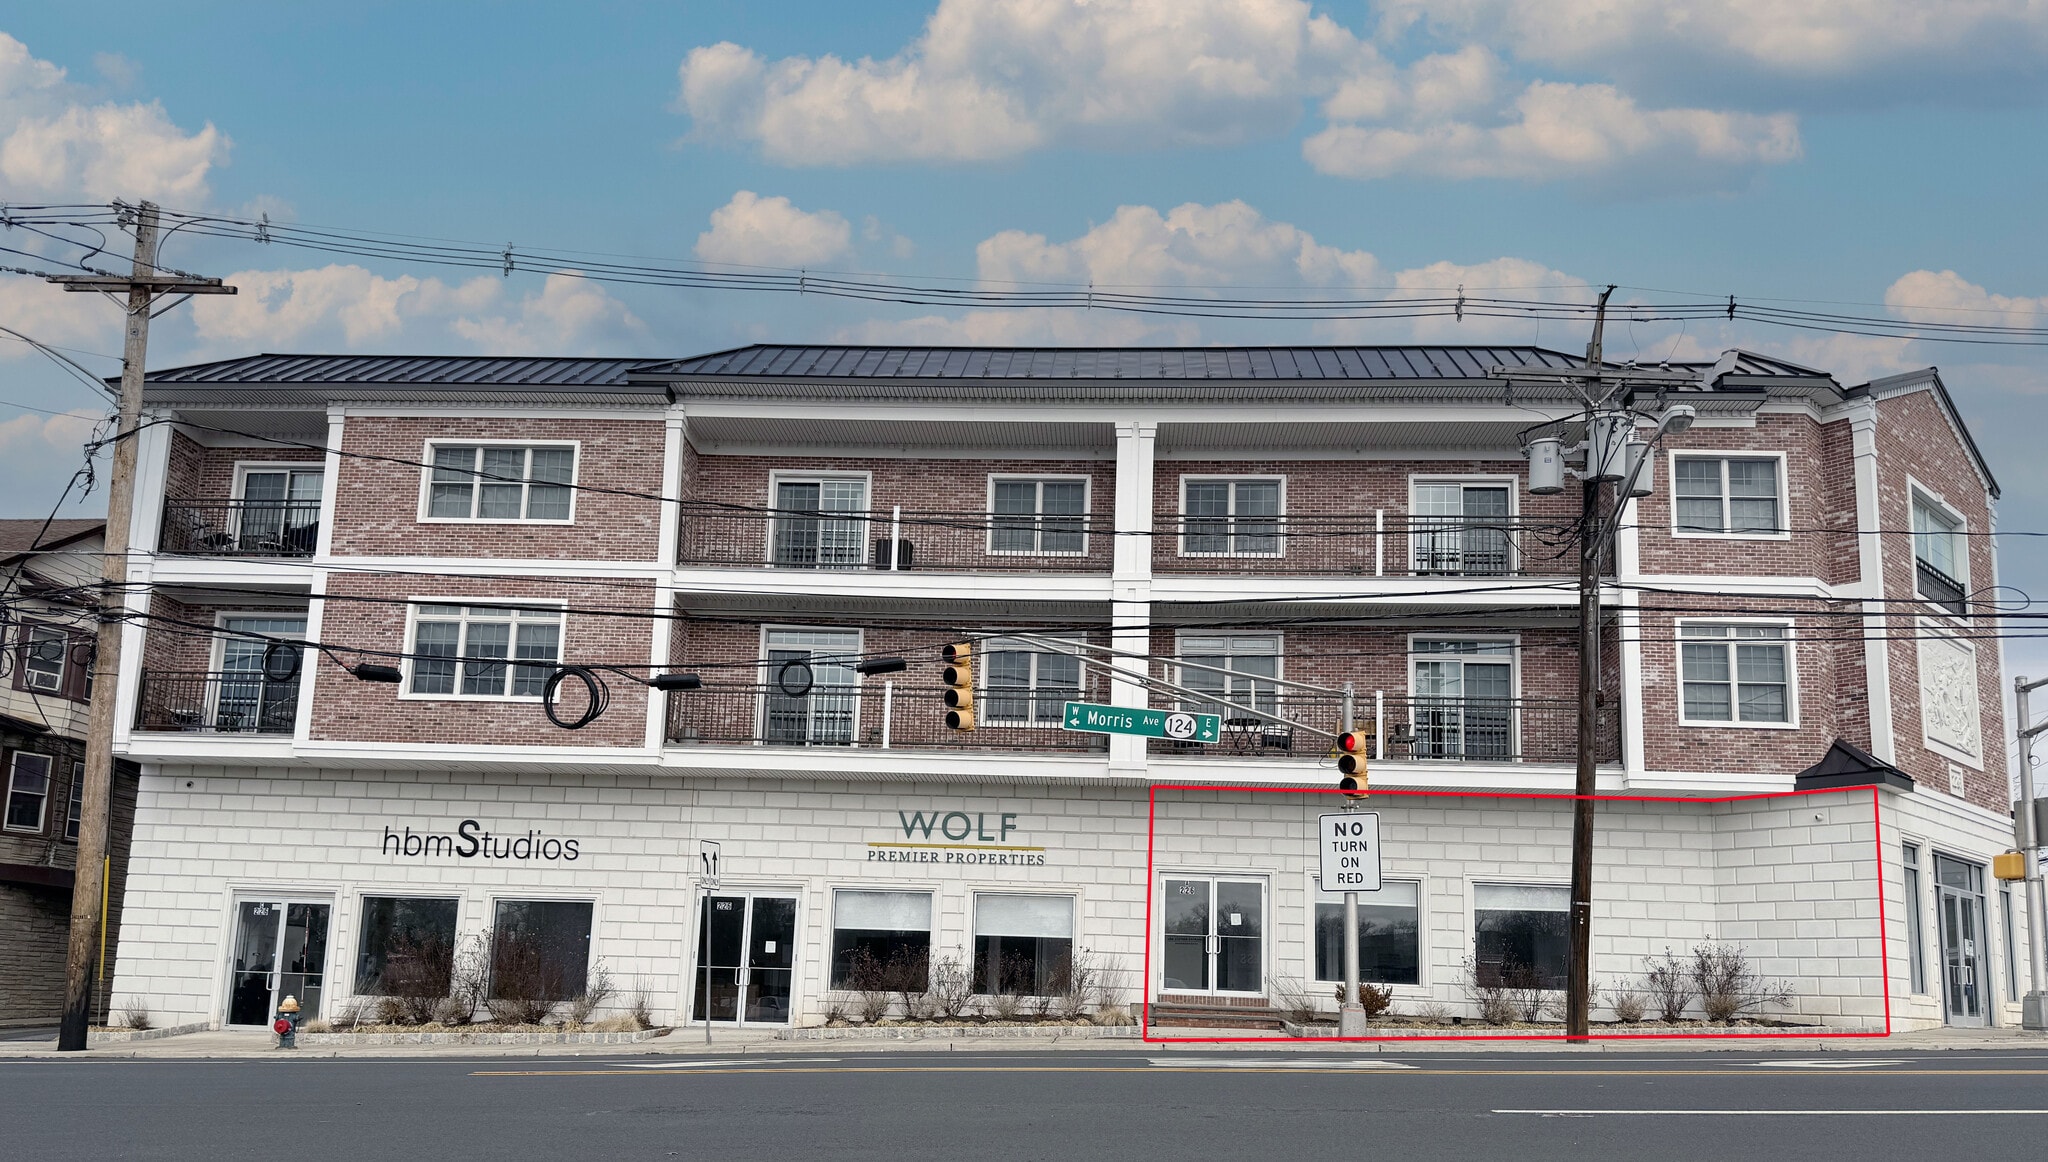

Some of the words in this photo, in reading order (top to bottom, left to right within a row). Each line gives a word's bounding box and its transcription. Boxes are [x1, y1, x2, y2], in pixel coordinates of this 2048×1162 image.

[1072, 706, 1079, 716] W
[1087, 710, 1133, 728] Morris
[1143, 715, 1160, 726] Ave
[1168, 718, 1193, 734] 124
[1206, 718, 1212, 728] E
[899, 810, 1017, 842] WOLF
[1334, 822, 1363, 837] NO
[382, 819, 580, 861] hbmStudios
[1332, 840, 1368, 852] TURN
[867, 850, 940, 863] PREMIER
[946, 851, 1045, 866] PROPERTIES
[1341, 856, 1359, 868] ON
[1337, 872, 1364, 884] RED
